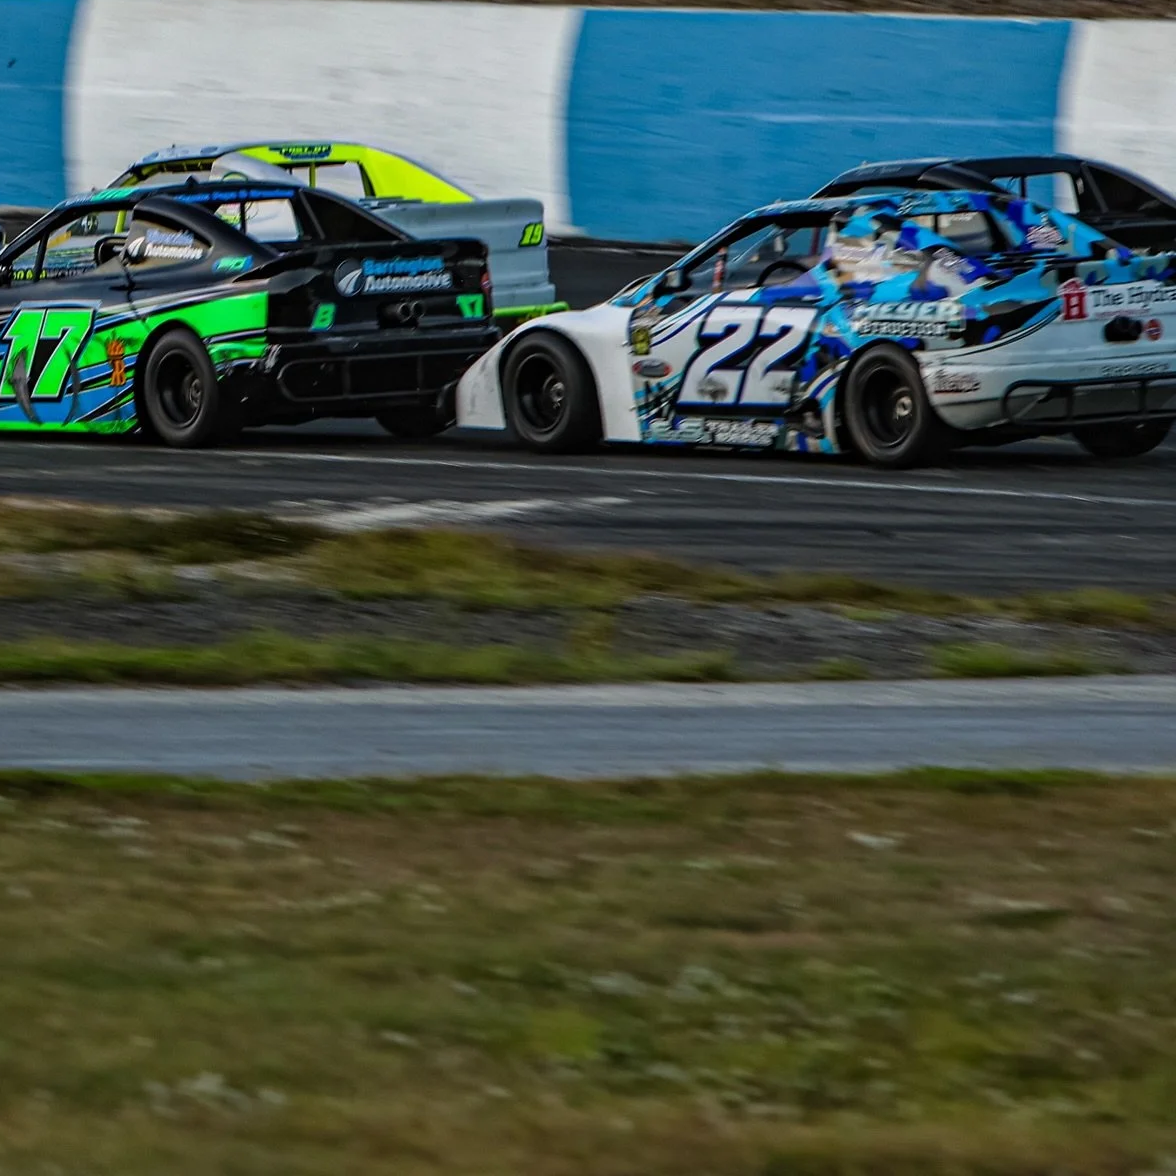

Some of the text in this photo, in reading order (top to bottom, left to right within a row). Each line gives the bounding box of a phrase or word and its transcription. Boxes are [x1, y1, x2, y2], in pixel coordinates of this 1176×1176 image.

[519, 223, 544, 246] 19
[144, 242, 204, 260] Automotive
[363, 272, 453, 292] Automotive
[456, 293, 486, 318] 17
[1062, 291, 1089, 321] H
[1090, 289, 1123, 308] The
[856, 302, 961, 322] MEYER
[677, 307, 818, 406] 22
